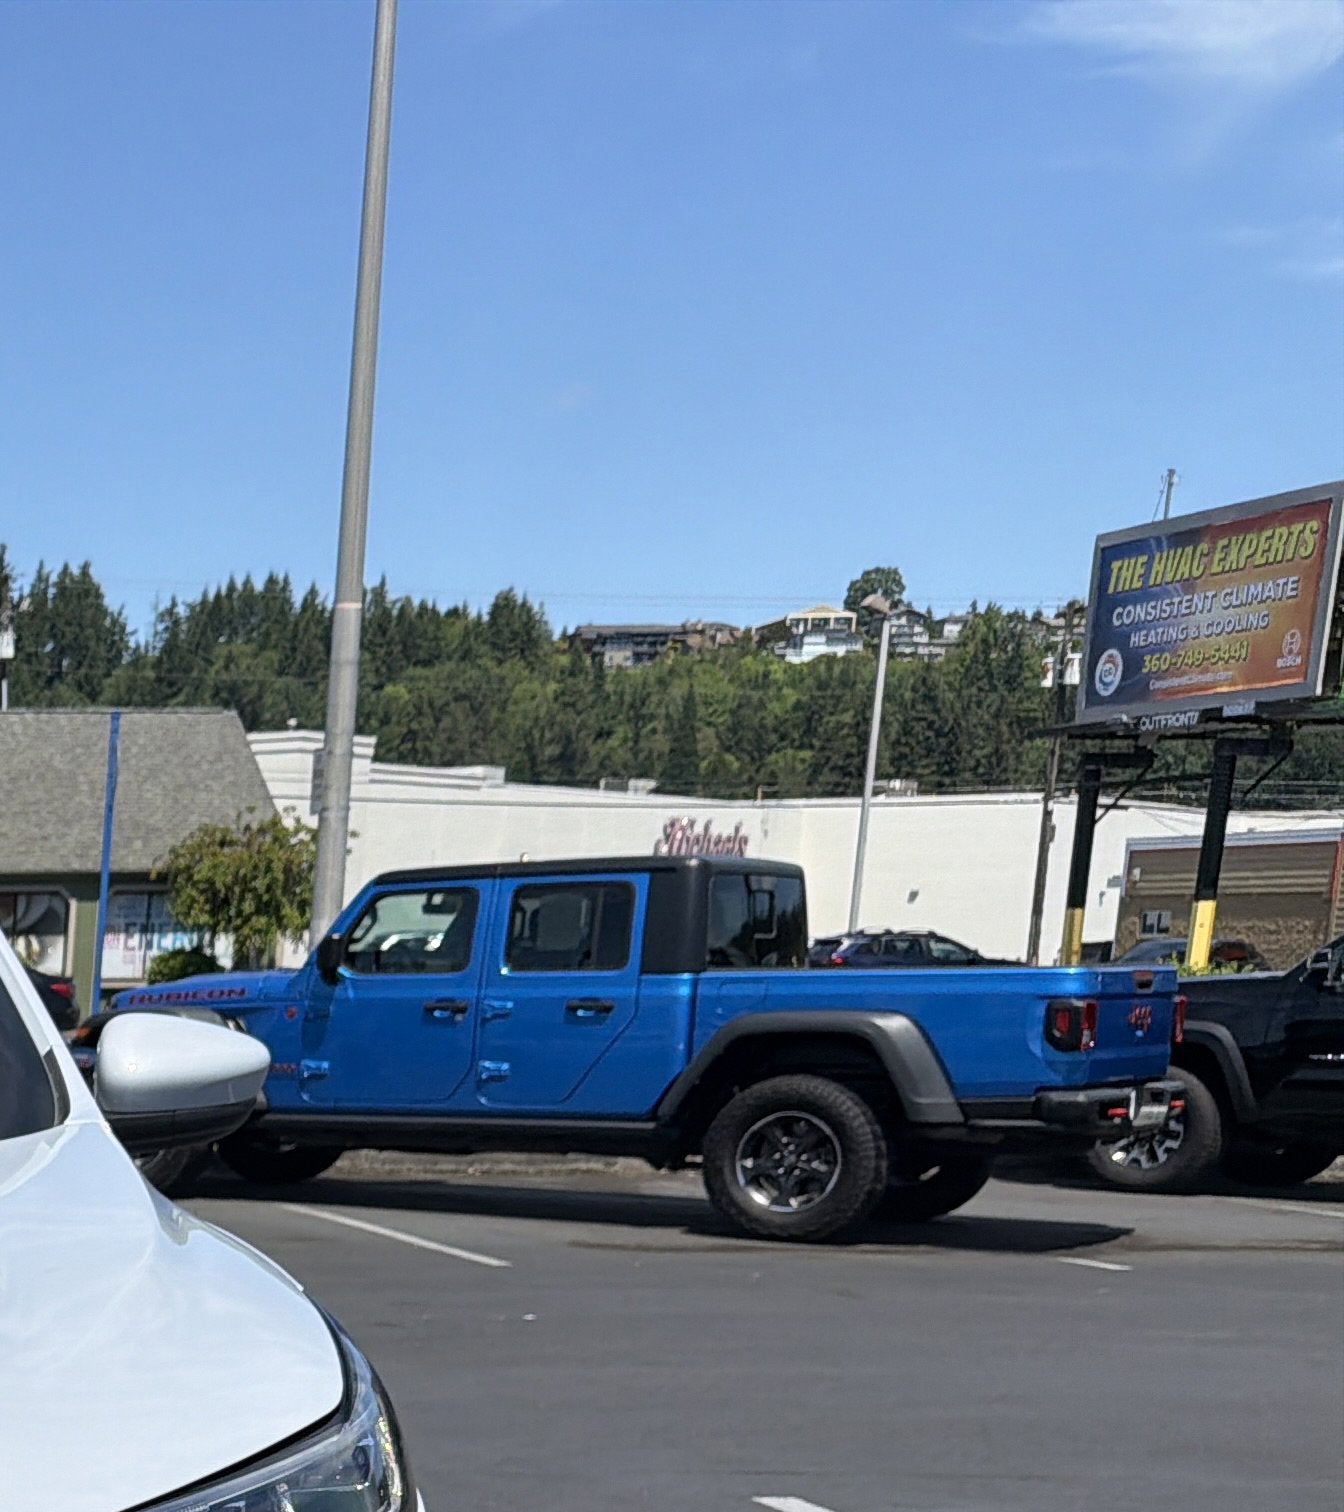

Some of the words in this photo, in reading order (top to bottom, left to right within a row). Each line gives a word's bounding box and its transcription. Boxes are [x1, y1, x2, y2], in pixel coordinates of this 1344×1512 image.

[1107, 554, 1149, 594] THE
[1149, 542, 1210, 587] HVAC
[1211, 520, 1319, 575] EXPERTS
[1112, 590, 1217, 627] CONSISTENT
[1220, 576, 1300, 608] CLIMATE
[1129, 624, 1191, 648] HEATING
[1189, 624, 1200, 637] &
[1204, 610, 1269, 638] COOLING
[128, 986, 247, 1005] RUBICON
